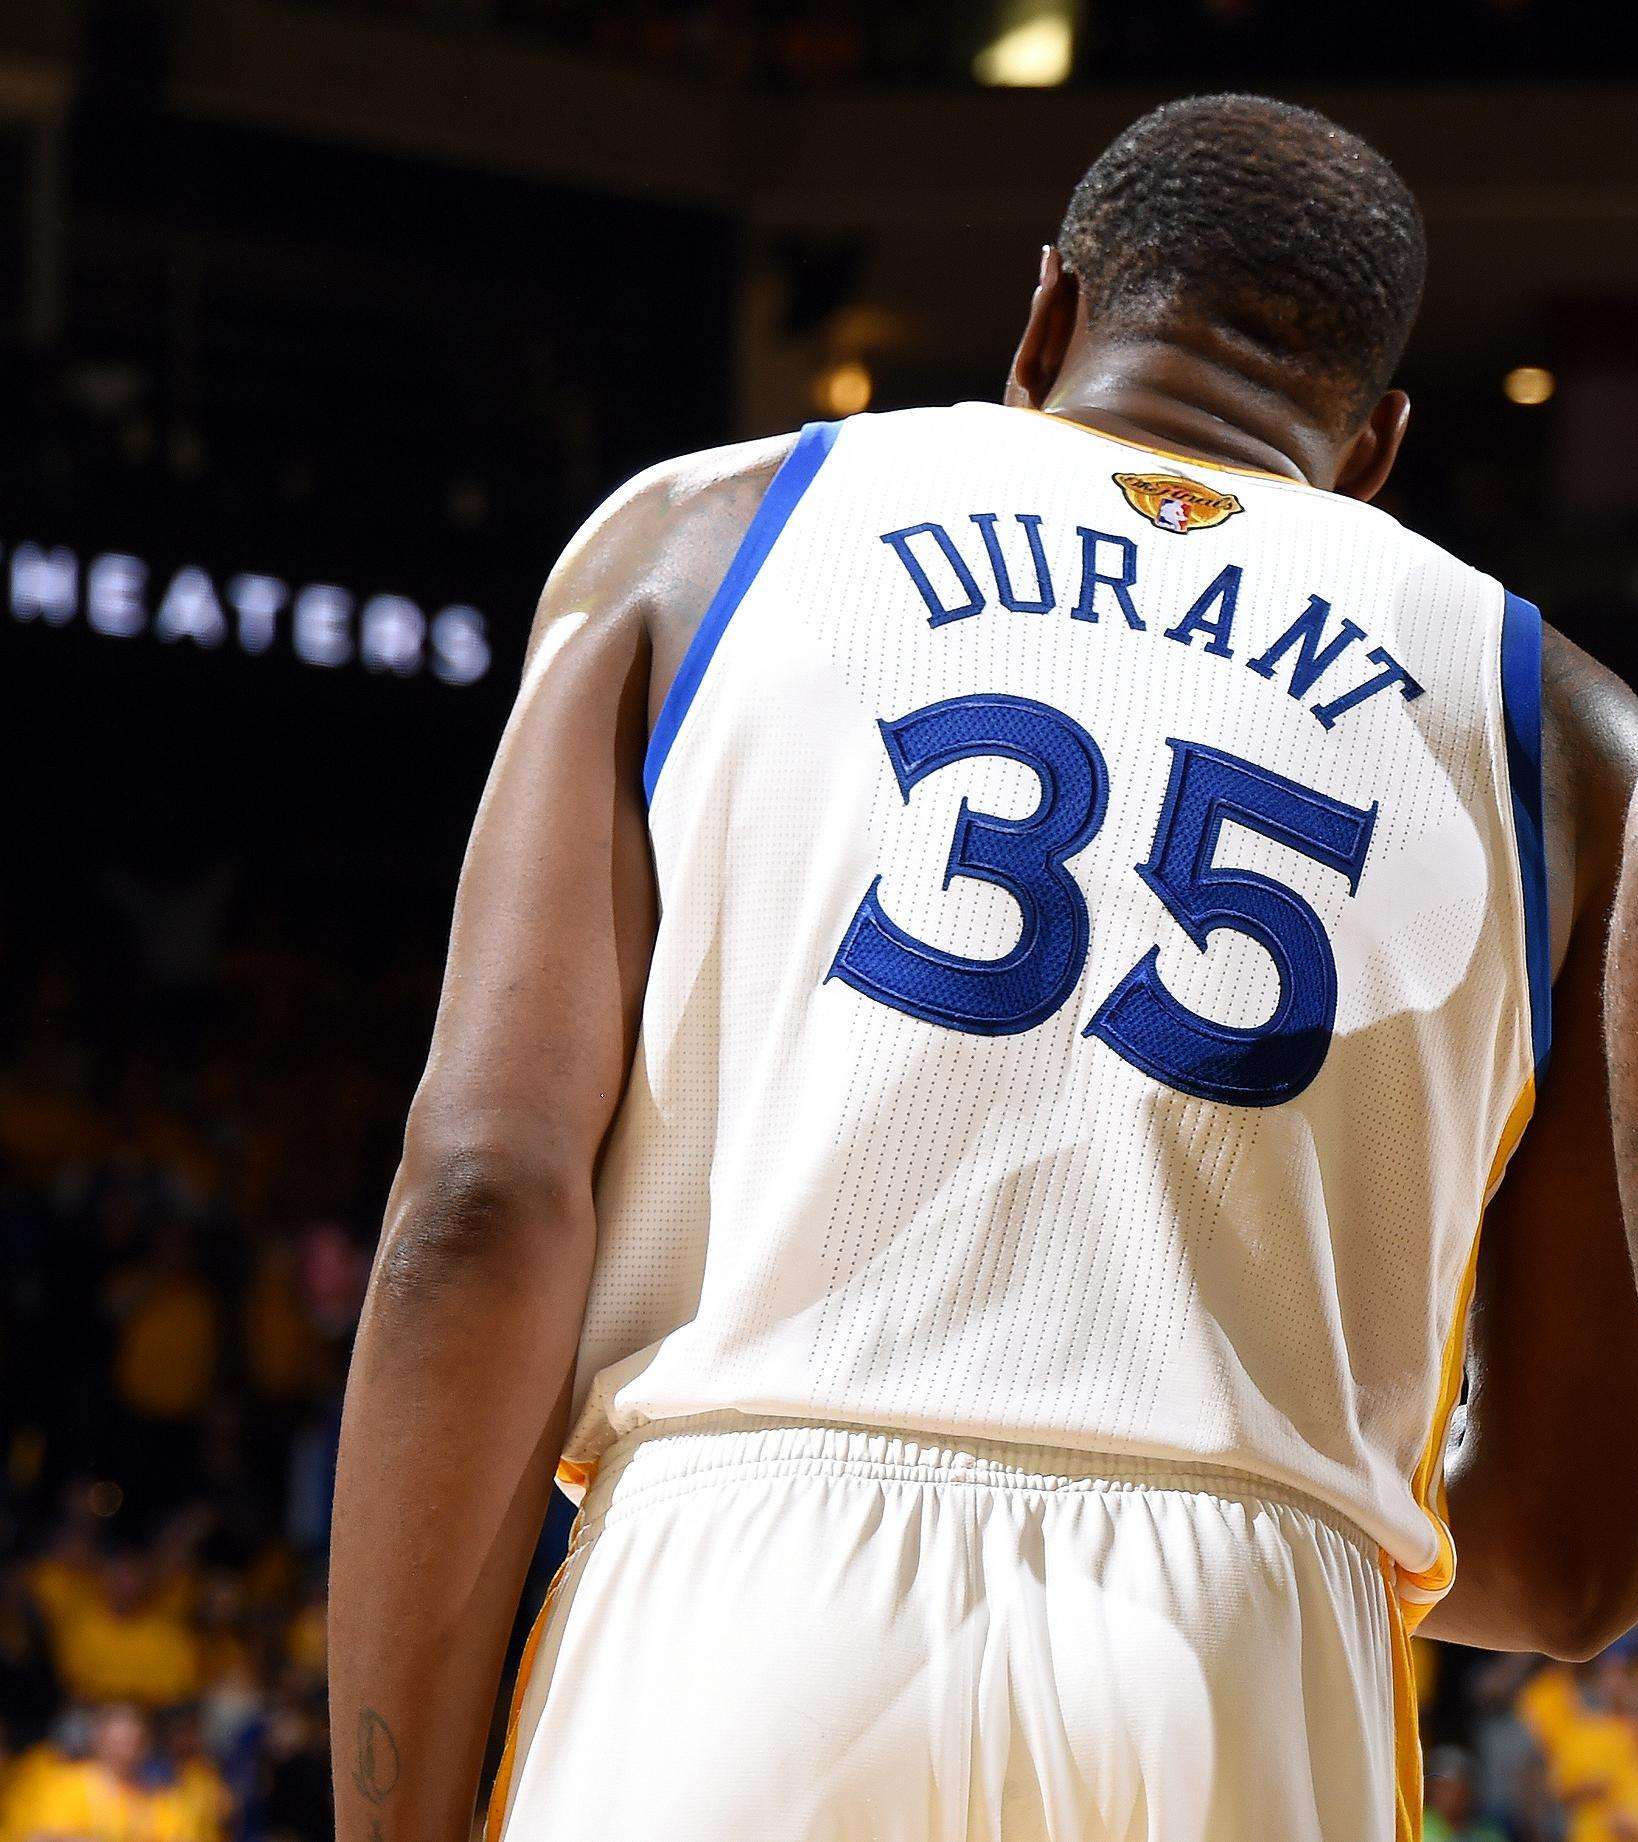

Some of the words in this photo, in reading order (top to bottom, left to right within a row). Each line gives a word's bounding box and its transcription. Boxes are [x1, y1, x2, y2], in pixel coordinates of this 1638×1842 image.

[0, 540, 492, 687] HEATERS
[880, 513, 1425, 732] DURANT
[823, 693, 1379, 1108] 35
